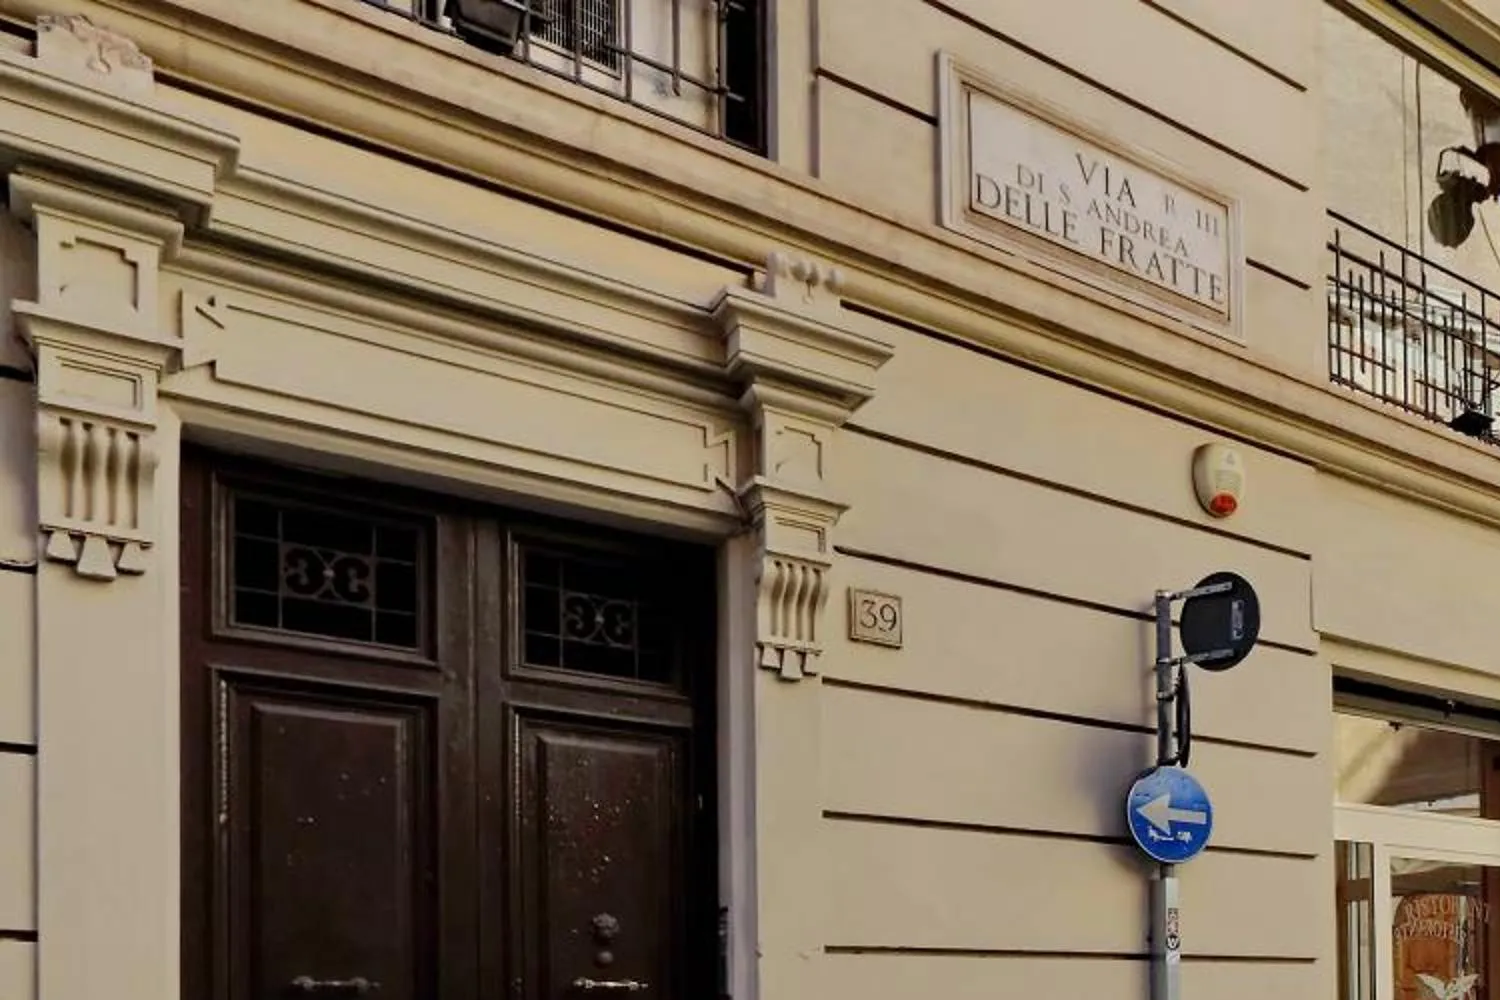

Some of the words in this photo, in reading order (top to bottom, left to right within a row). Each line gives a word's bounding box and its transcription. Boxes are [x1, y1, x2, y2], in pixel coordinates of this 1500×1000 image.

[1016, 163, 1044, 194] DI
[1086, 199, 1189, 257] ANDREA
[1075, 152, 1136, 208] VIA
[975, 173, 1080, 245] DELLE
[1099, 226, 1224, 302] FRATTE
[860, 599, 897, 632] 39
